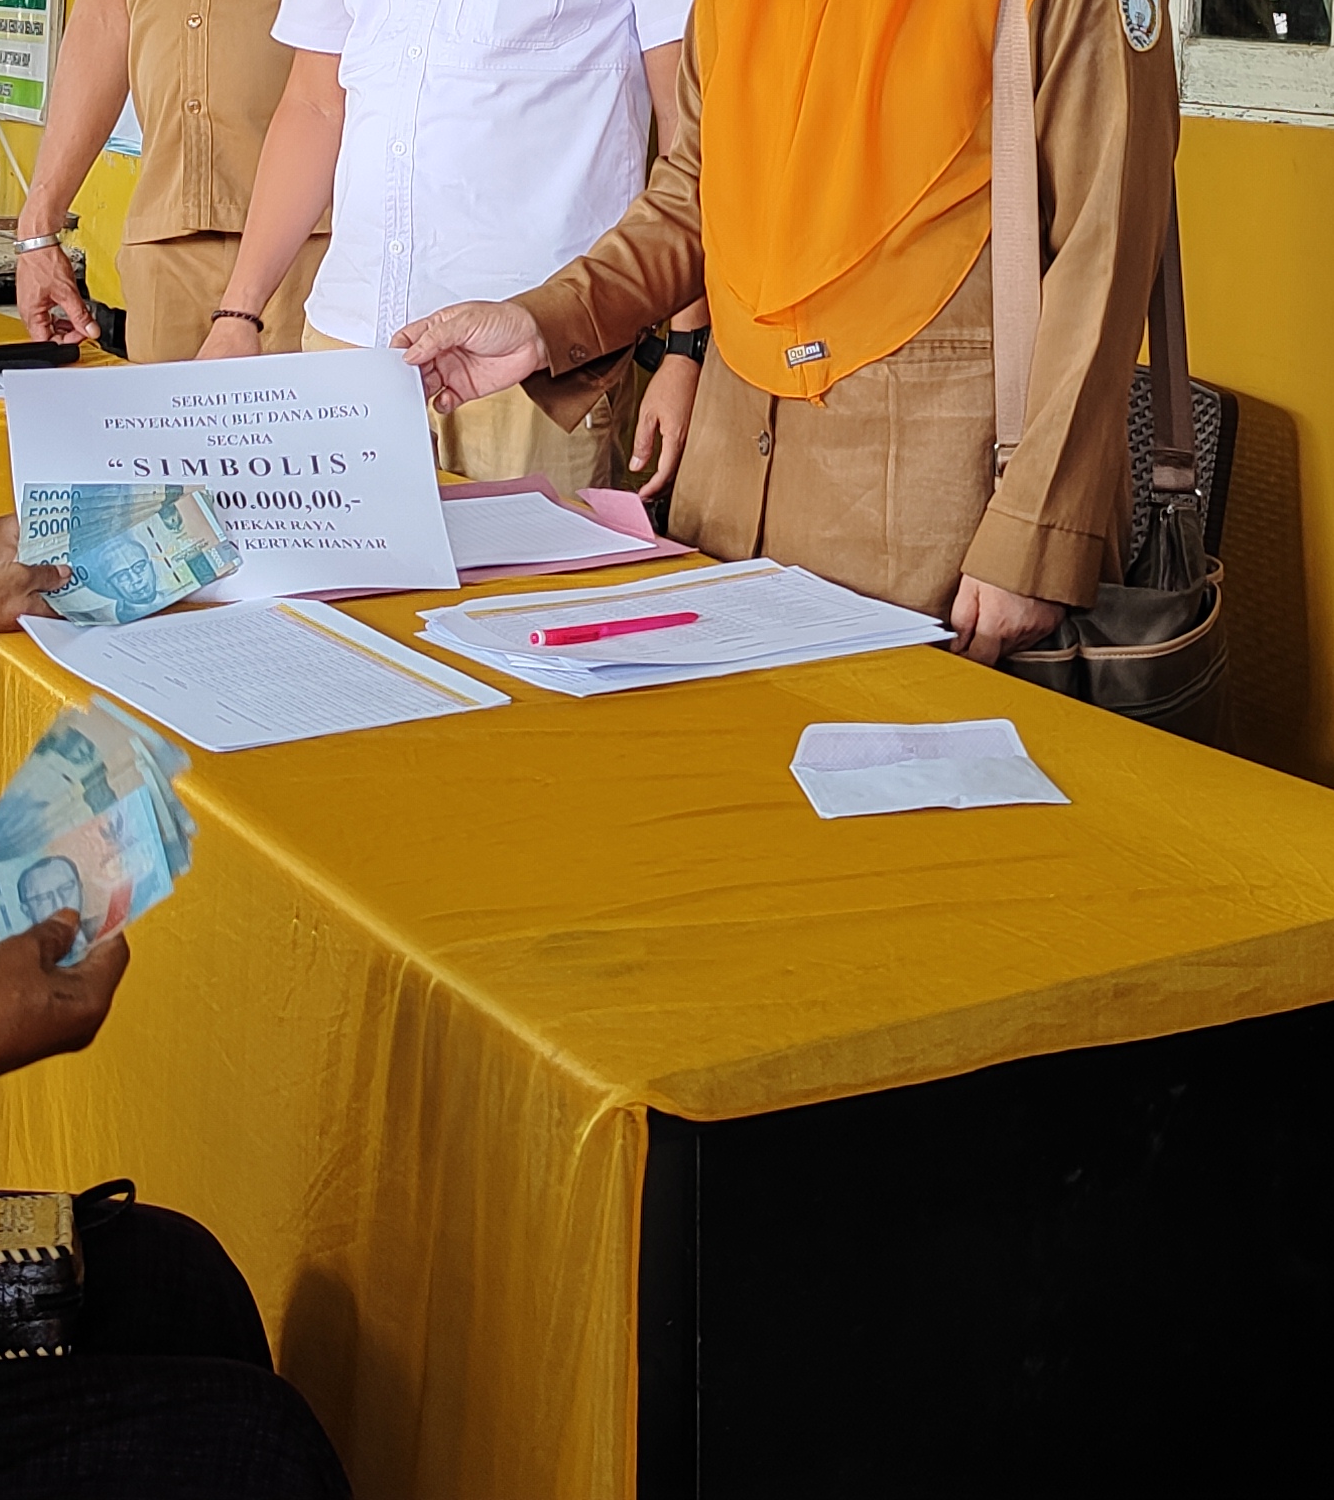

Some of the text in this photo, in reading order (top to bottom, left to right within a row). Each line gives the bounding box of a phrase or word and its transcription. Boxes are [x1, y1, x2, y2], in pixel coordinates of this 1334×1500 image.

[172, 388, 298, 409] SERAH TERIMA
[104, 407, 217, 431] PENYERAHAN
[232, 411, 264, 426] BLT
[267, 407, 314, 424] DANA
[317, 403, 360, 420] DESA
[207, 432, 273, 448] SECARA
[224, 519, 336, 532] MEKAR RAYA
[245, 537, 315, 550] KERTAK
[319, 537, 387, 550] HANYAR
